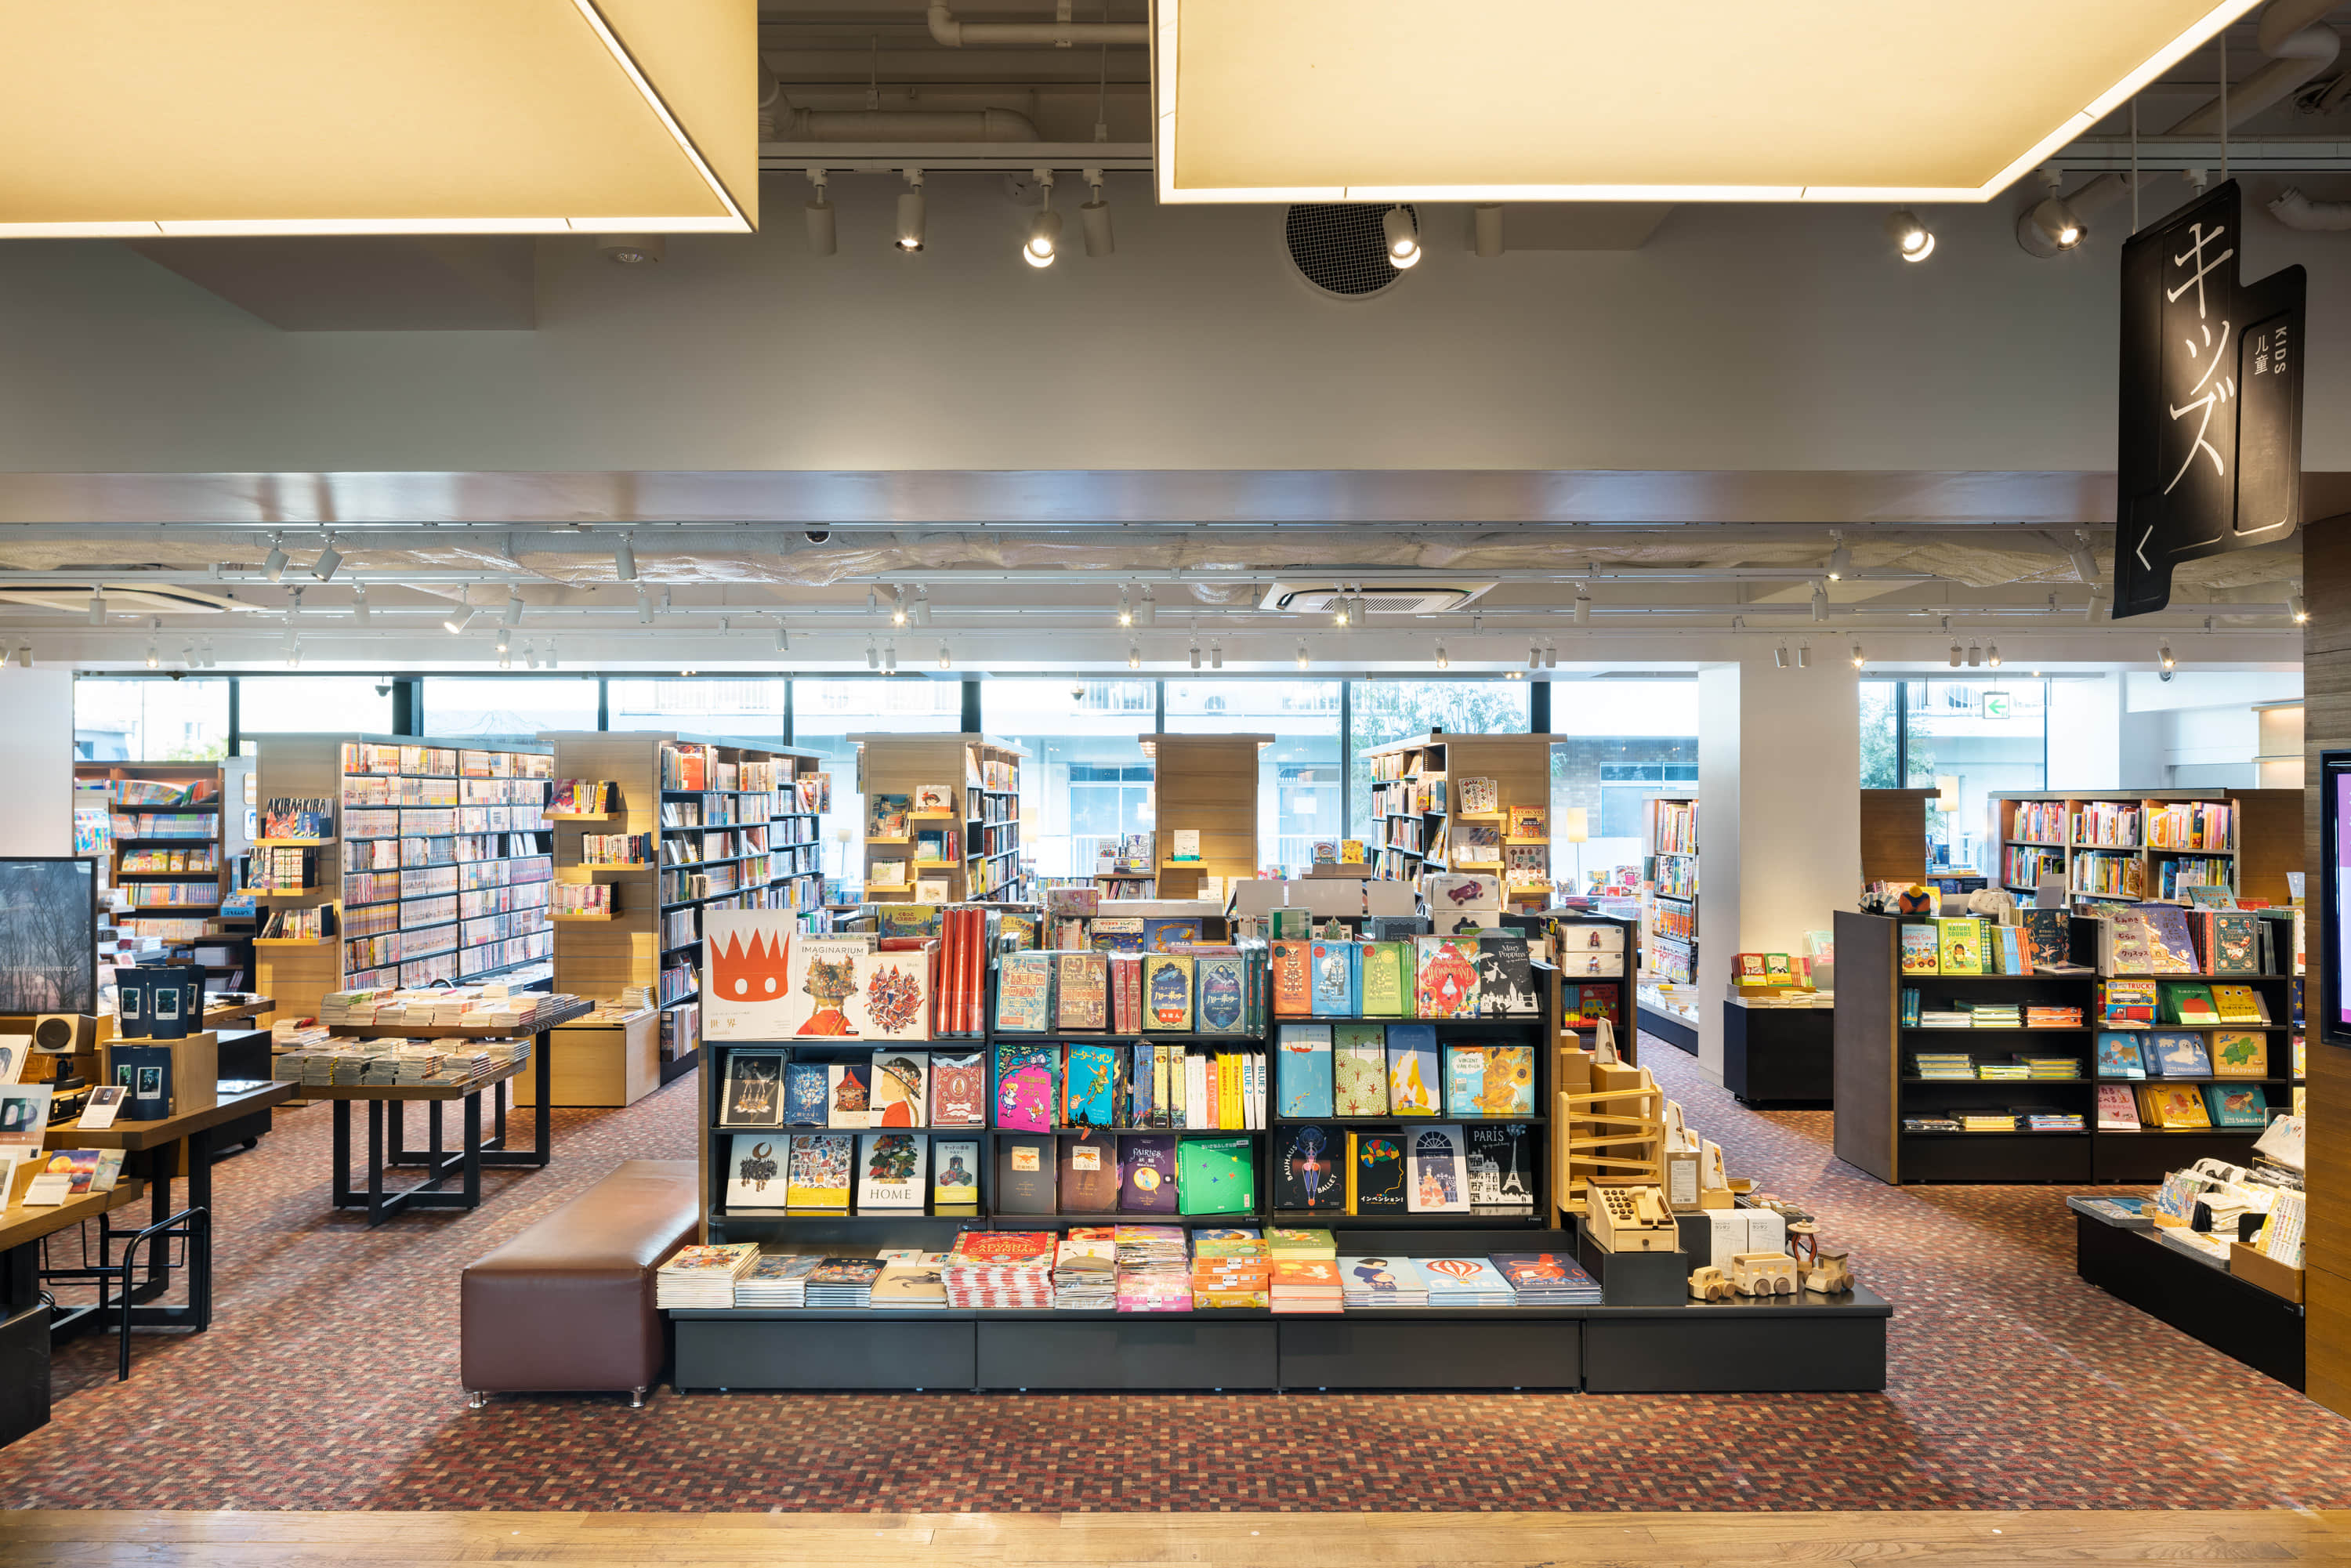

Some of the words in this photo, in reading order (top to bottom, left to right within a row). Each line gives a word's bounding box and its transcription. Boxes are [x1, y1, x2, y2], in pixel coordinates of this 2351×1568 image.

[2164, 223, 2234, 494] キッズ
[2254, 334, 2270, 376] 儿童
[2273, 325, 2288, 375] KIDS
[1498, 951, 1526, 959] Poppins
[1473, 1130, 1505, 1143] PARIS
[1284, 1145, 1298, 1182] BAUHAUS
[869, 1188, 911, 1200] HOME
[1317, 1174, 1337, 1194] BALLET
